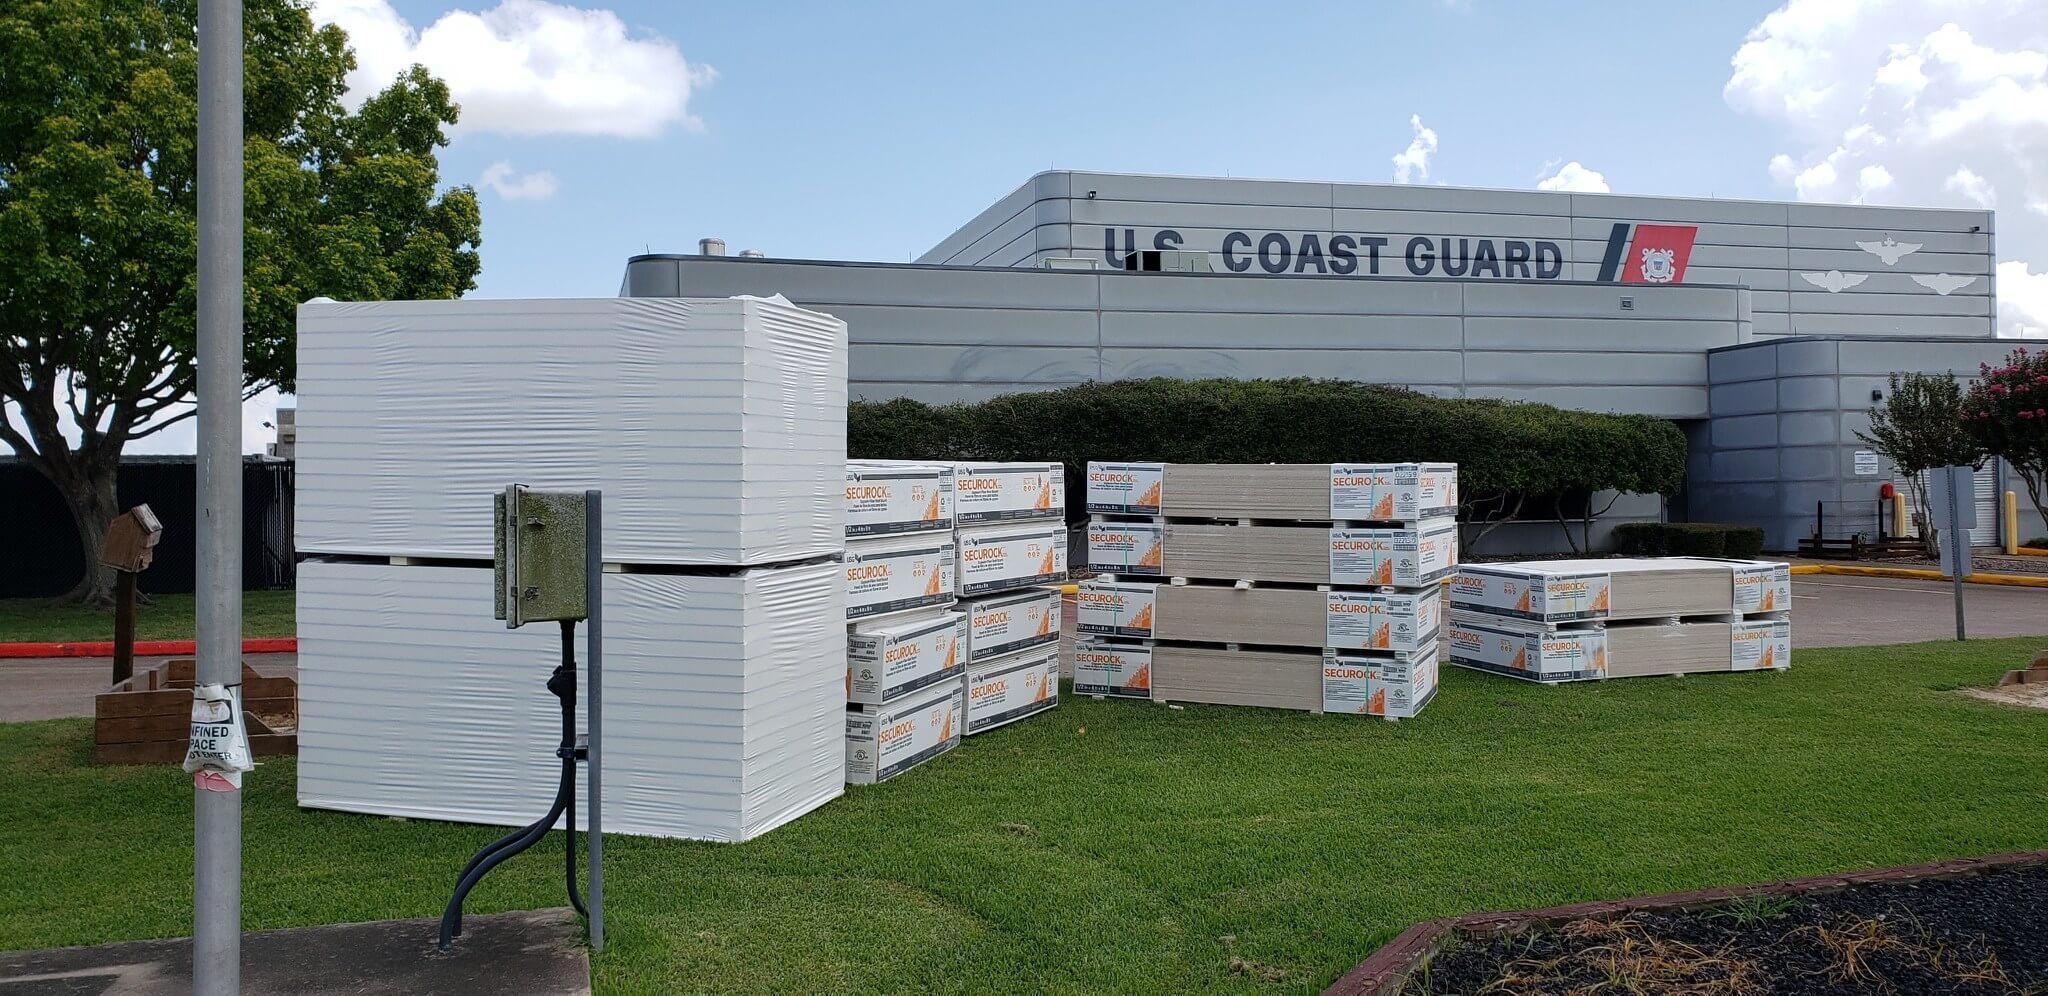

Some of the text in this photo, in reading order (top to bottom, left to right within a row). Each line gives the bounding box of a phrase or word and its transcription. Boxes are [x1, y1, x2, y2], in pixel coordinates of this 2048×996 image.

[1222, 231, 1388, 274] COAST
[1405, 236, 1563, 279] GUARD
[1089, 473, 1133, 482] SECUROCK
[1333, 477, 1384, 486] SECUROCK
[958, 478, 998, 490] SECUROCK
[846, 486, 887, 500] SECUROCK
[1090, 534, 1134, 543] SECUROCK
[1332, 541, 1383, 550] SECUROCK
[964, 547, 1003, 561] SECUROCK
[847, 564, 888, 580] SECUROCK
[1451, 576, 1483, 587] SECUROCK
[1547, 582, 1585, 592] SECUROCK
[1078, 592, 1124, 604] SECUROCK
[1329, 603, 1381, 614] SECUROCK
[973, 611, 1008, 628] SECUROCK
[1542, 641, 1581, 651] SECUROCK
[885, 643, 918, 663] SECUROCK
[1076, 653, 1121, 664] SECUROCK
[1324, 668, 1377, 679] SECUROCK
[971, 680, 1006, 699] SECUROCK
[880, 720, 913, 743] SECUROCK
[202, 751, 232, 760] ENTER
